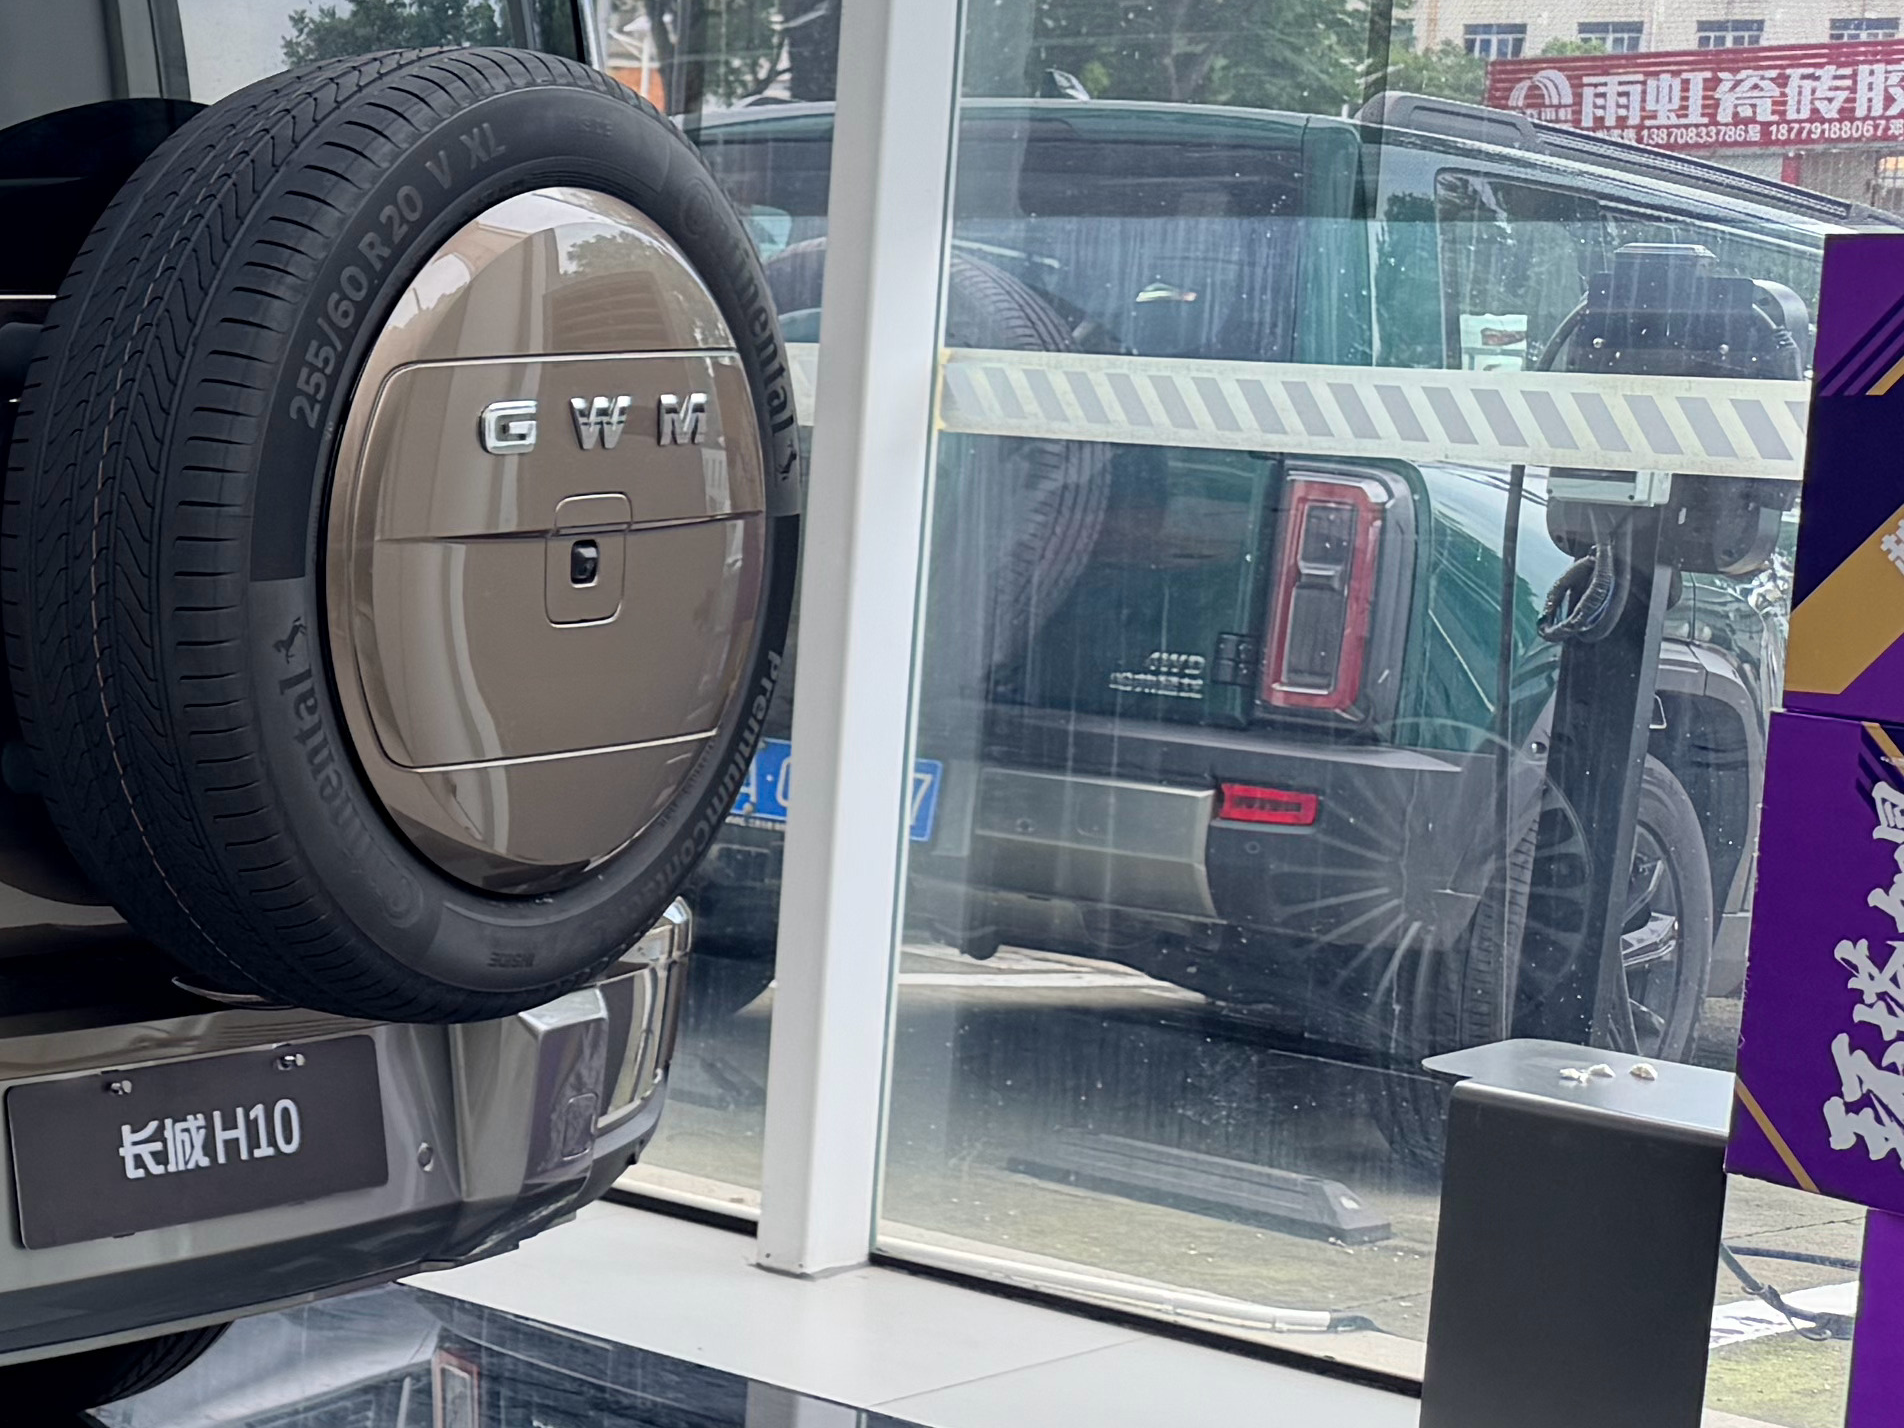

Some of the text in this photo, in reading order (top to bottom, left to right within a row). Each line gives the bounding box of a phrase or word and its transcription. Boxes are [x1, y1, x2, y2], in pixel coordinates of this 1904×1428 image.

[1580, 62, 1904, 129] 雨虹瓷砖胶
[459, 122, 506, 170] XL
[478, 392, 708, 455] GWM
